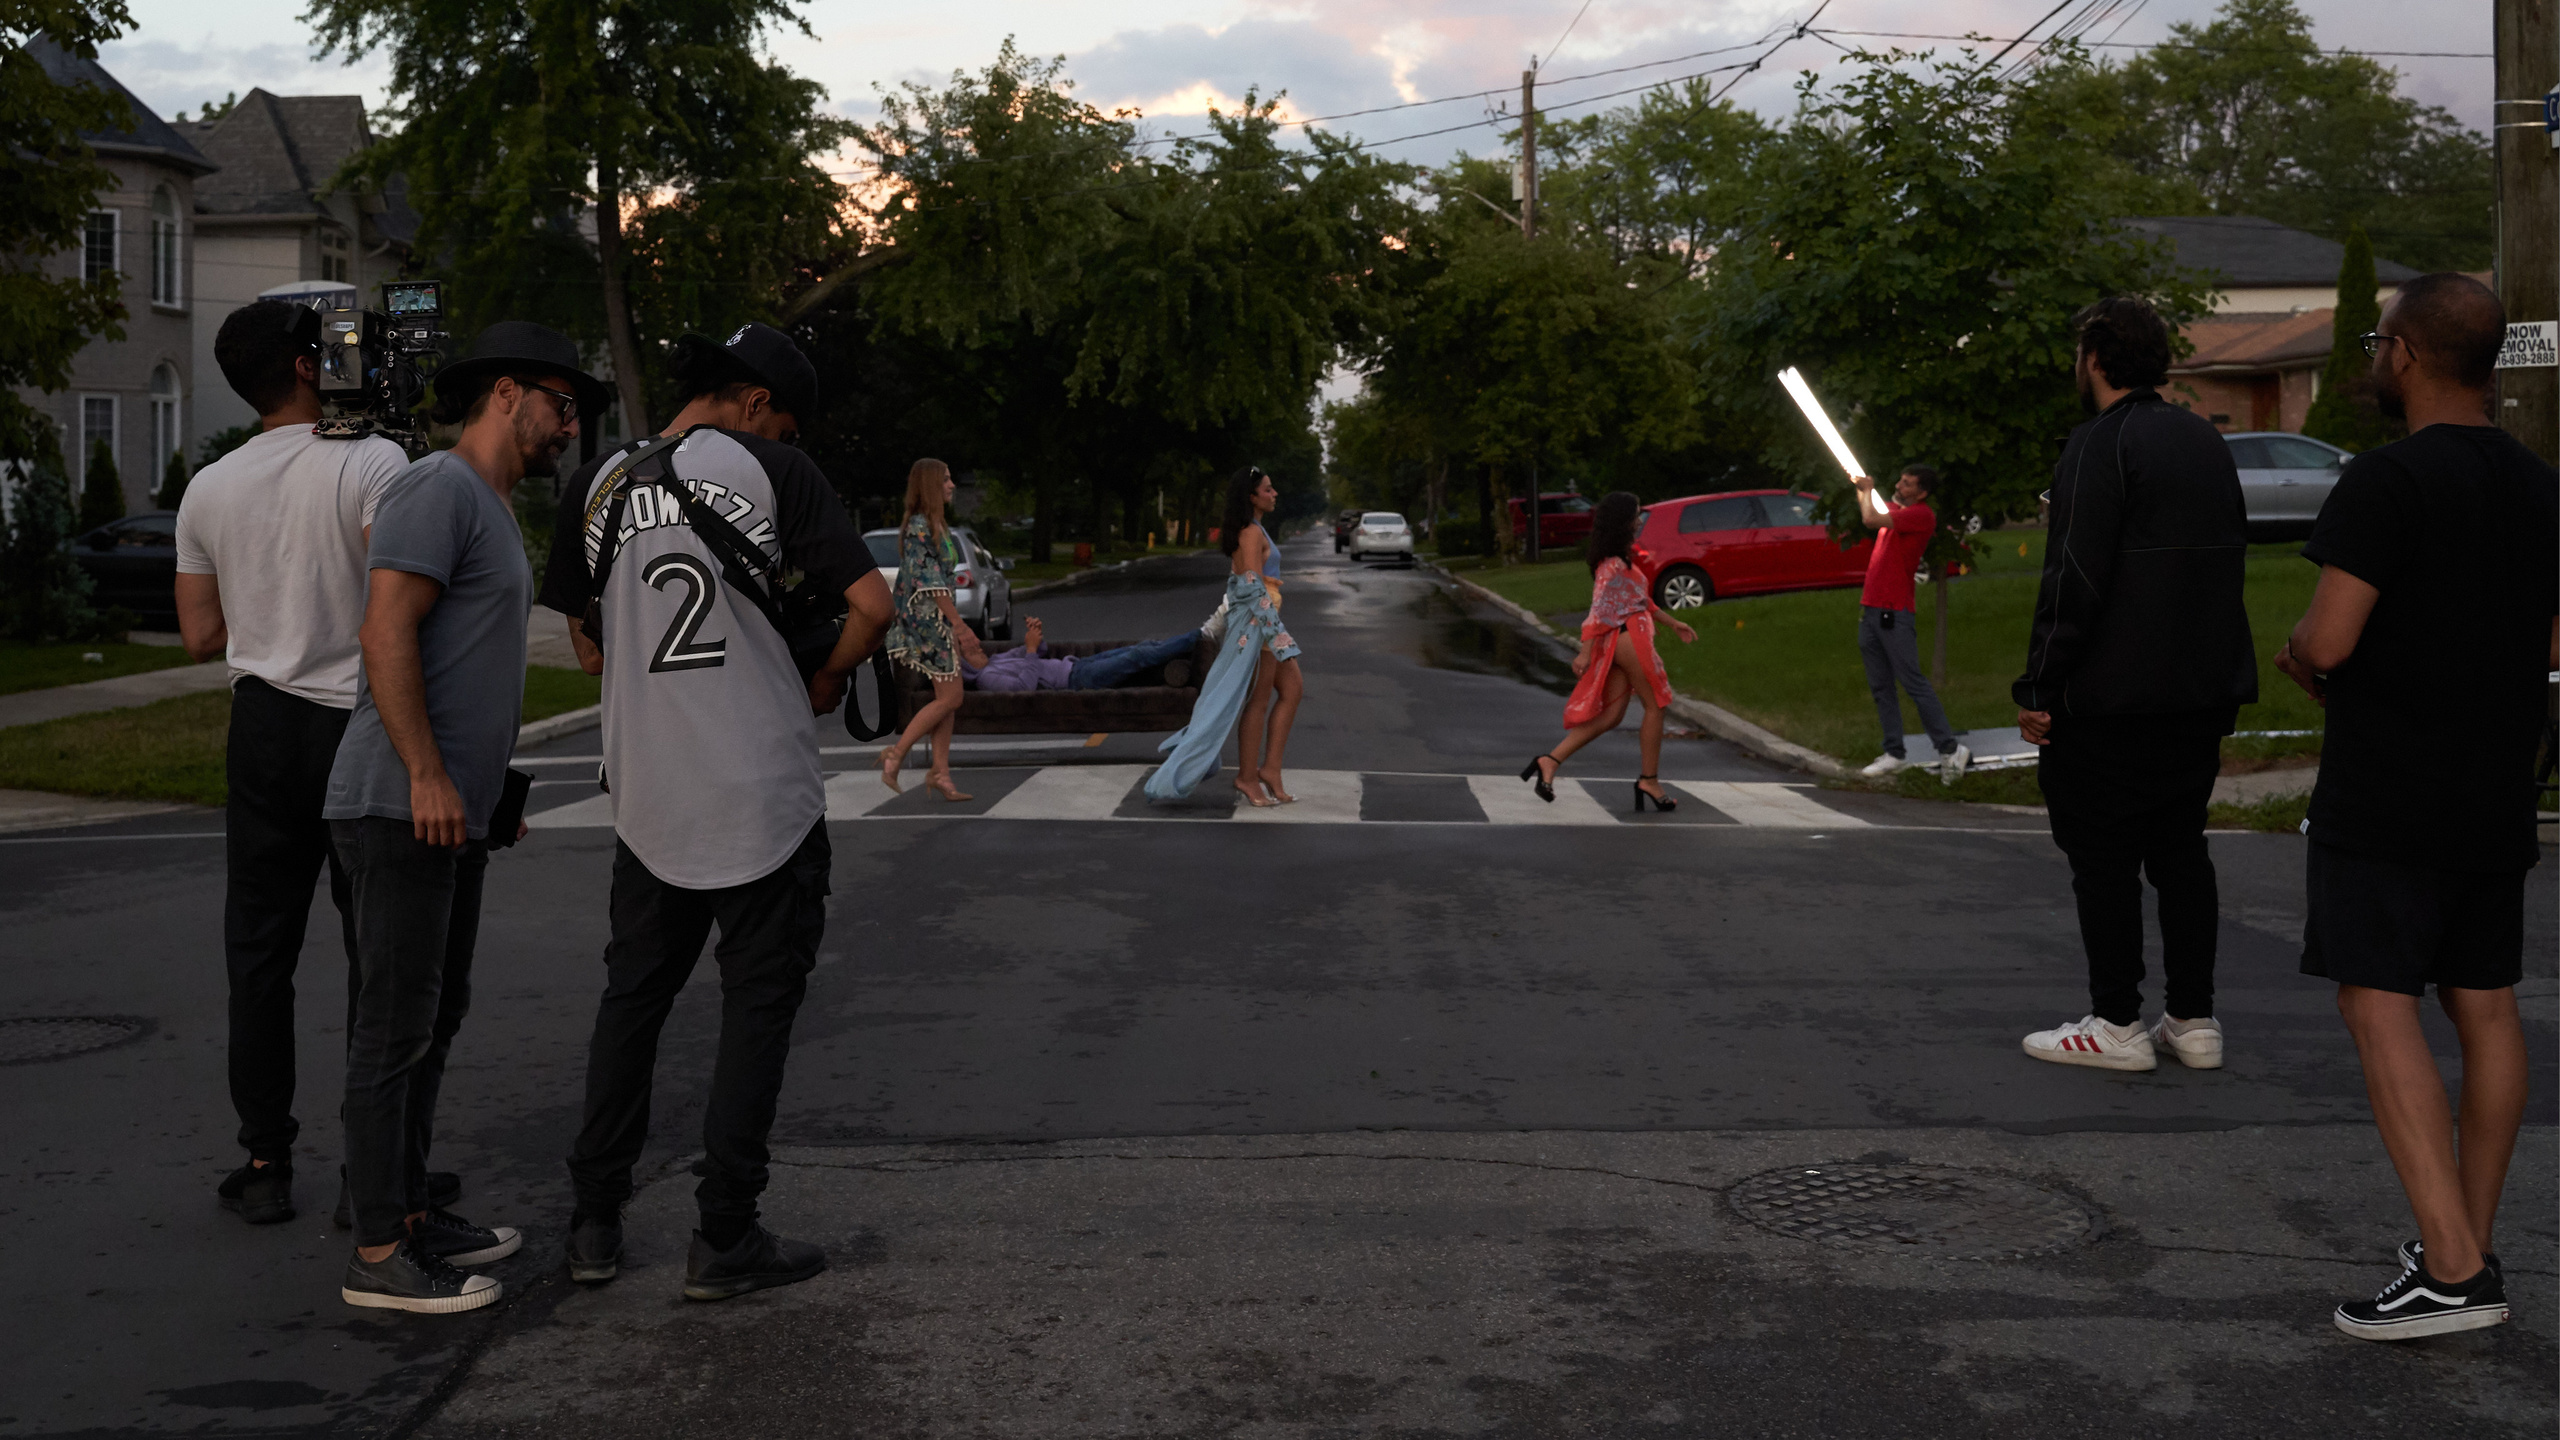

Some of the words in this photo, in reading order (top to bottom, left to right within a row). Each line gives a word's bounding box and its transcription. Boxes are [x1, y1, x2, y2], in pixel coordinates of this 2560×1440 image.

[2499, 339, 2555, 353] EMOVAL
[2496, 352, 2555, 366] 16-939-2888
[641, 552, 727, 673] 2
